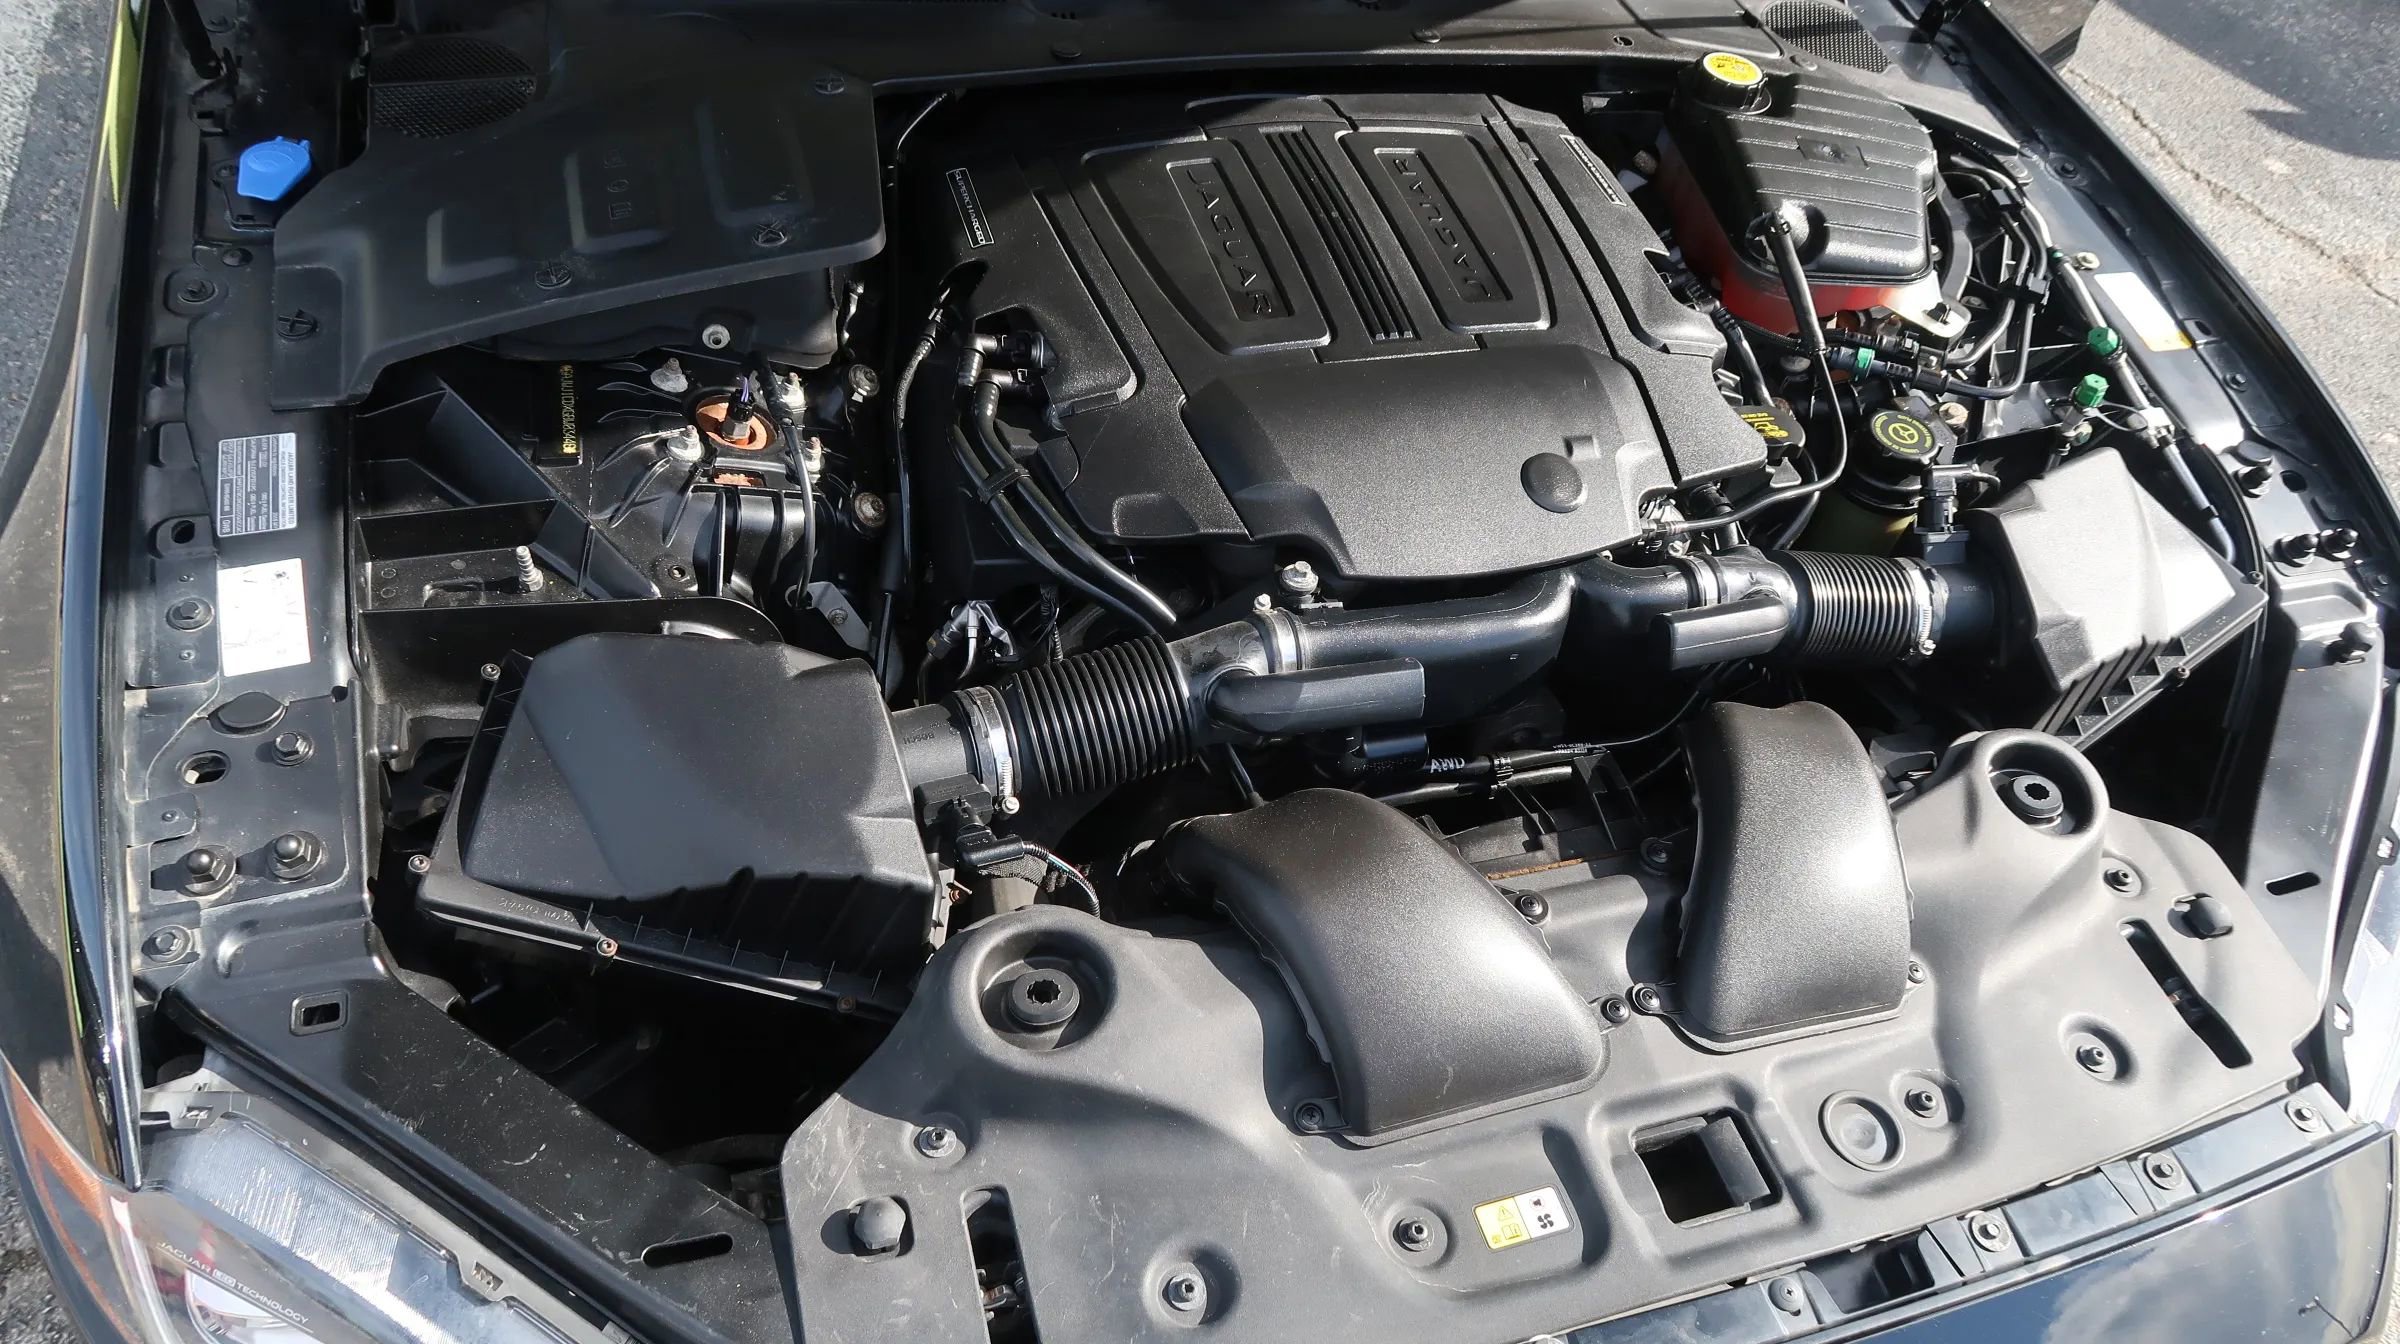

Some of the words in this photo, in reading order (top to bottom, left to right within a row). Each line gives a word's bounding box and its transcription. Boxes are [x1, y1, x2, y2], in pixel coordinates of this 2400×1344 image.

[954, 169, 986, 245] SUPERCHARGED
[1186, 169, 1272, 314] JAGUAR
[1392, 158, 1492, 298] JAGUAR
[1430, 757, 1466, 773] AWD
[157, 1241, 211, 1273] JAGUAR
[236, 1283, 309, 1325] TECHNOLOGY
